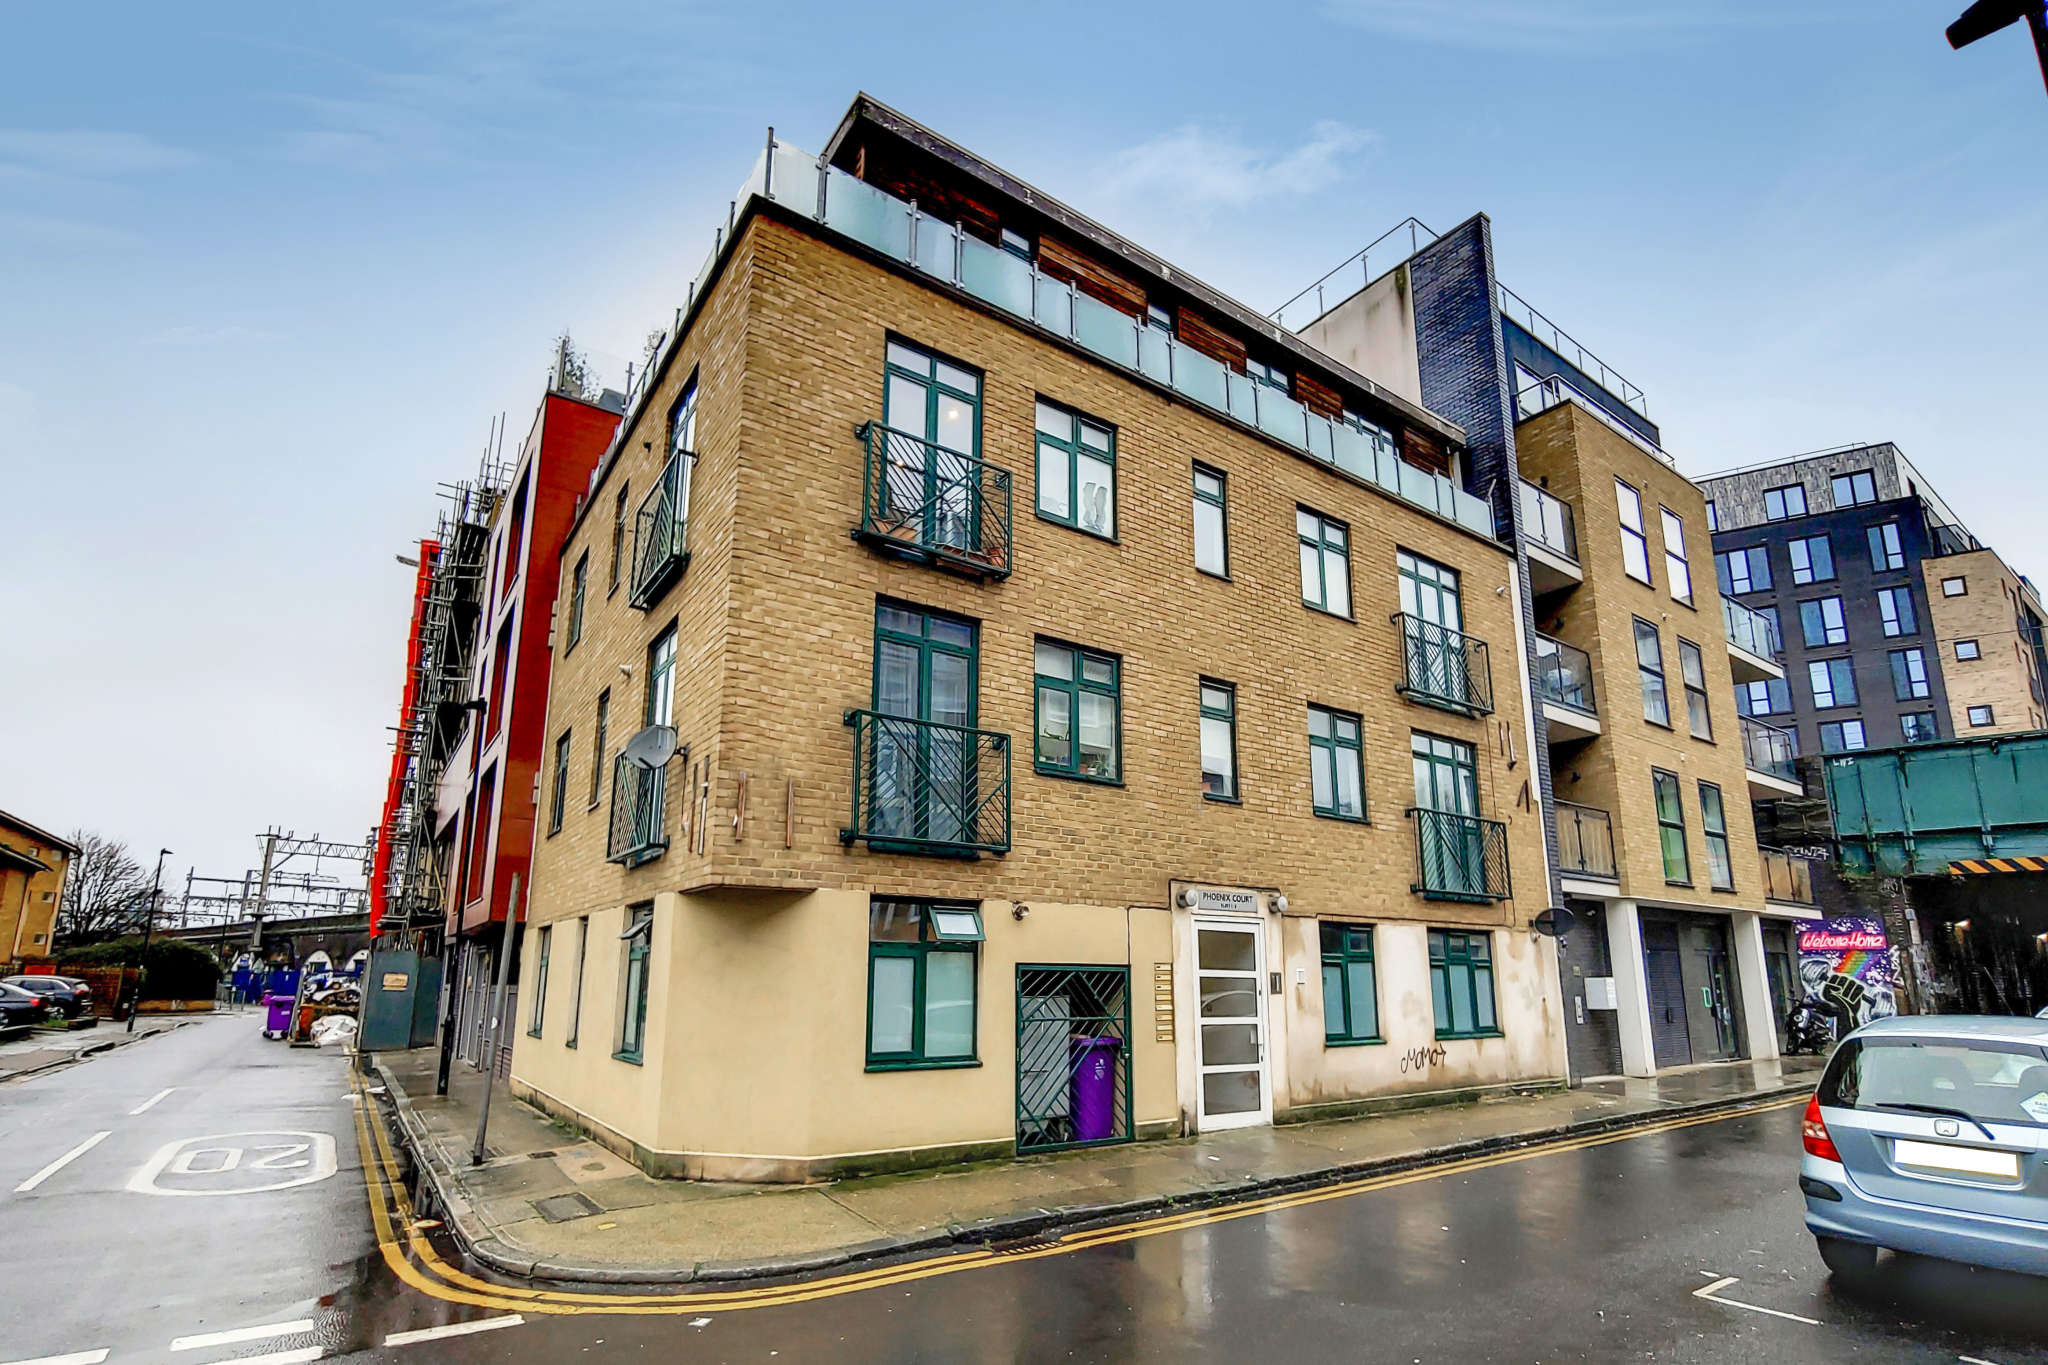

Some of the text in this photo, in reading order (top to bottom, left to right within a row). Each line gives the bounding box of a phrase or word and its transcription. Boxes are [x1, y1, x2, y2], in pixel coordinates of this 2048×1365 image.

[1202, 892, 1253, 903] PHOENIX COURT
[1849, 932, 1883, 947] Home
